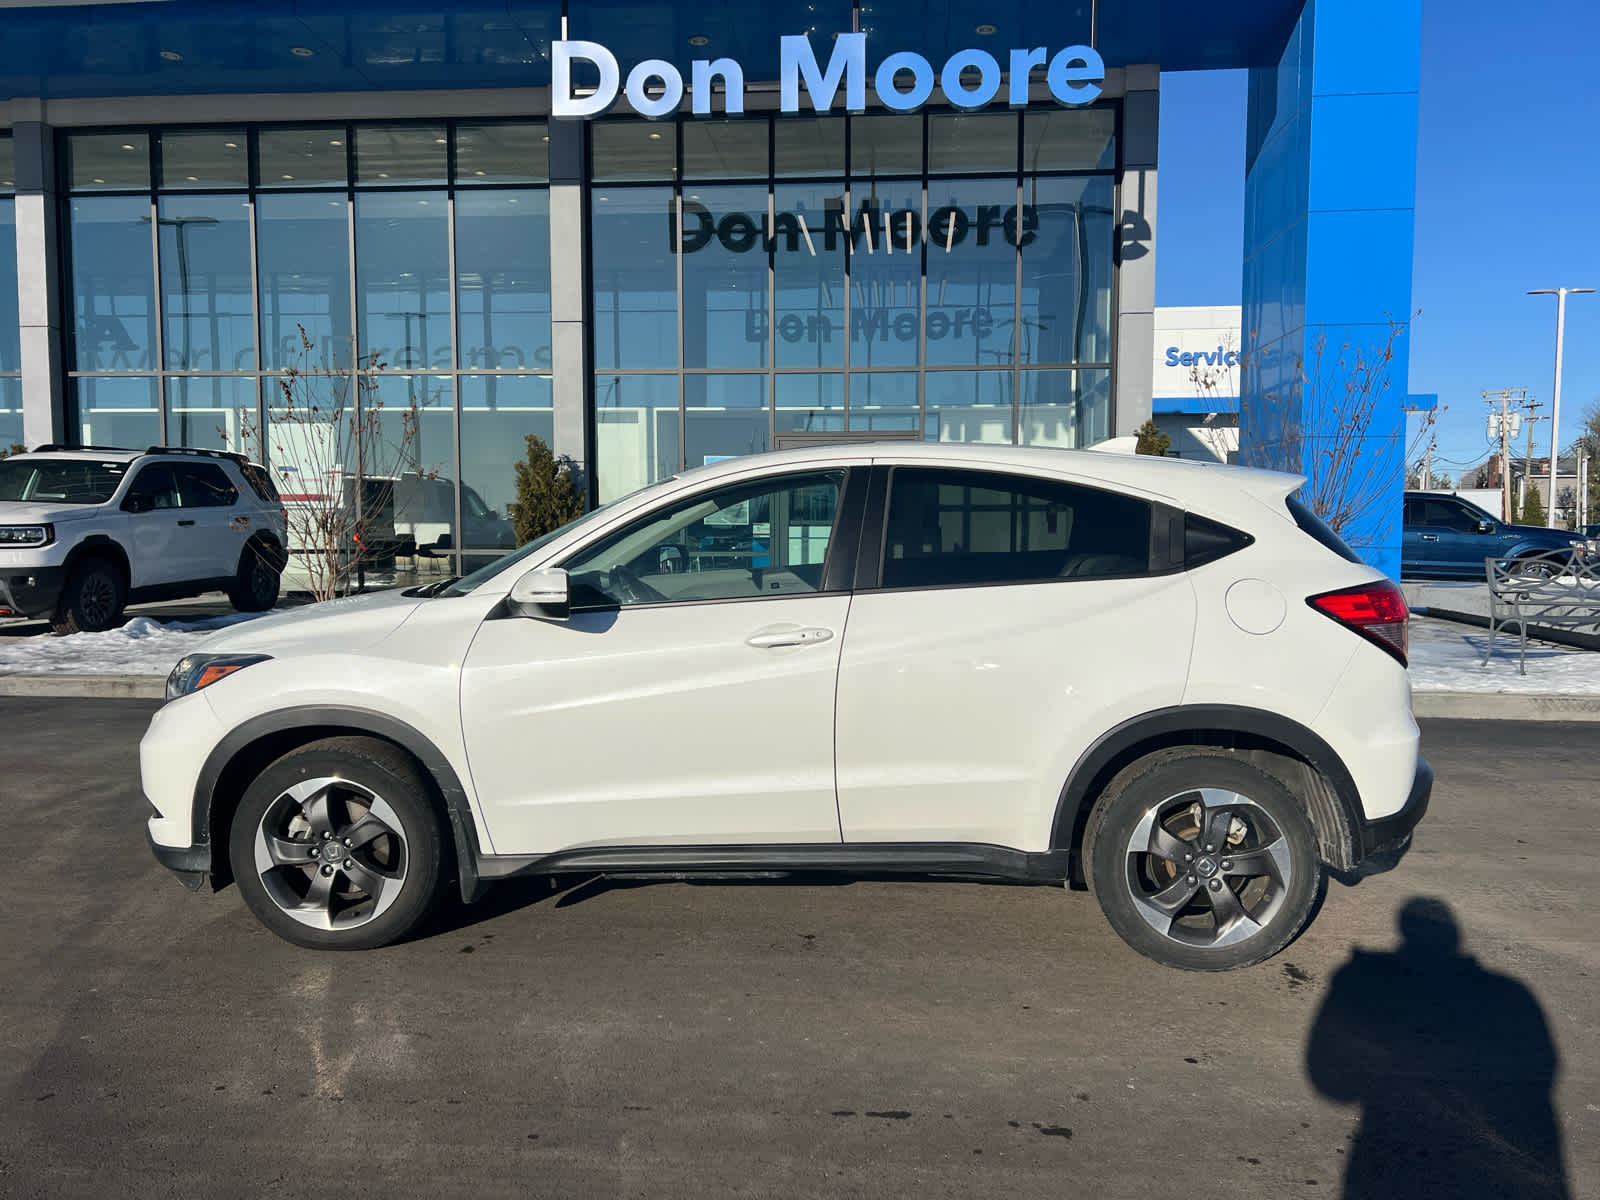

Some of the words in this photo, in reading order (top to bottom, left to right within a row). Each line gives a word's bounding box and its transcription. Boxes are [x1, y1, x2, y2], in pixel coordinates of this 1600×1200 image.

[551, 39, 744, 118] Don
[780, 32, 1105, 114] Moore
[668, 198, 798, 255] Don
